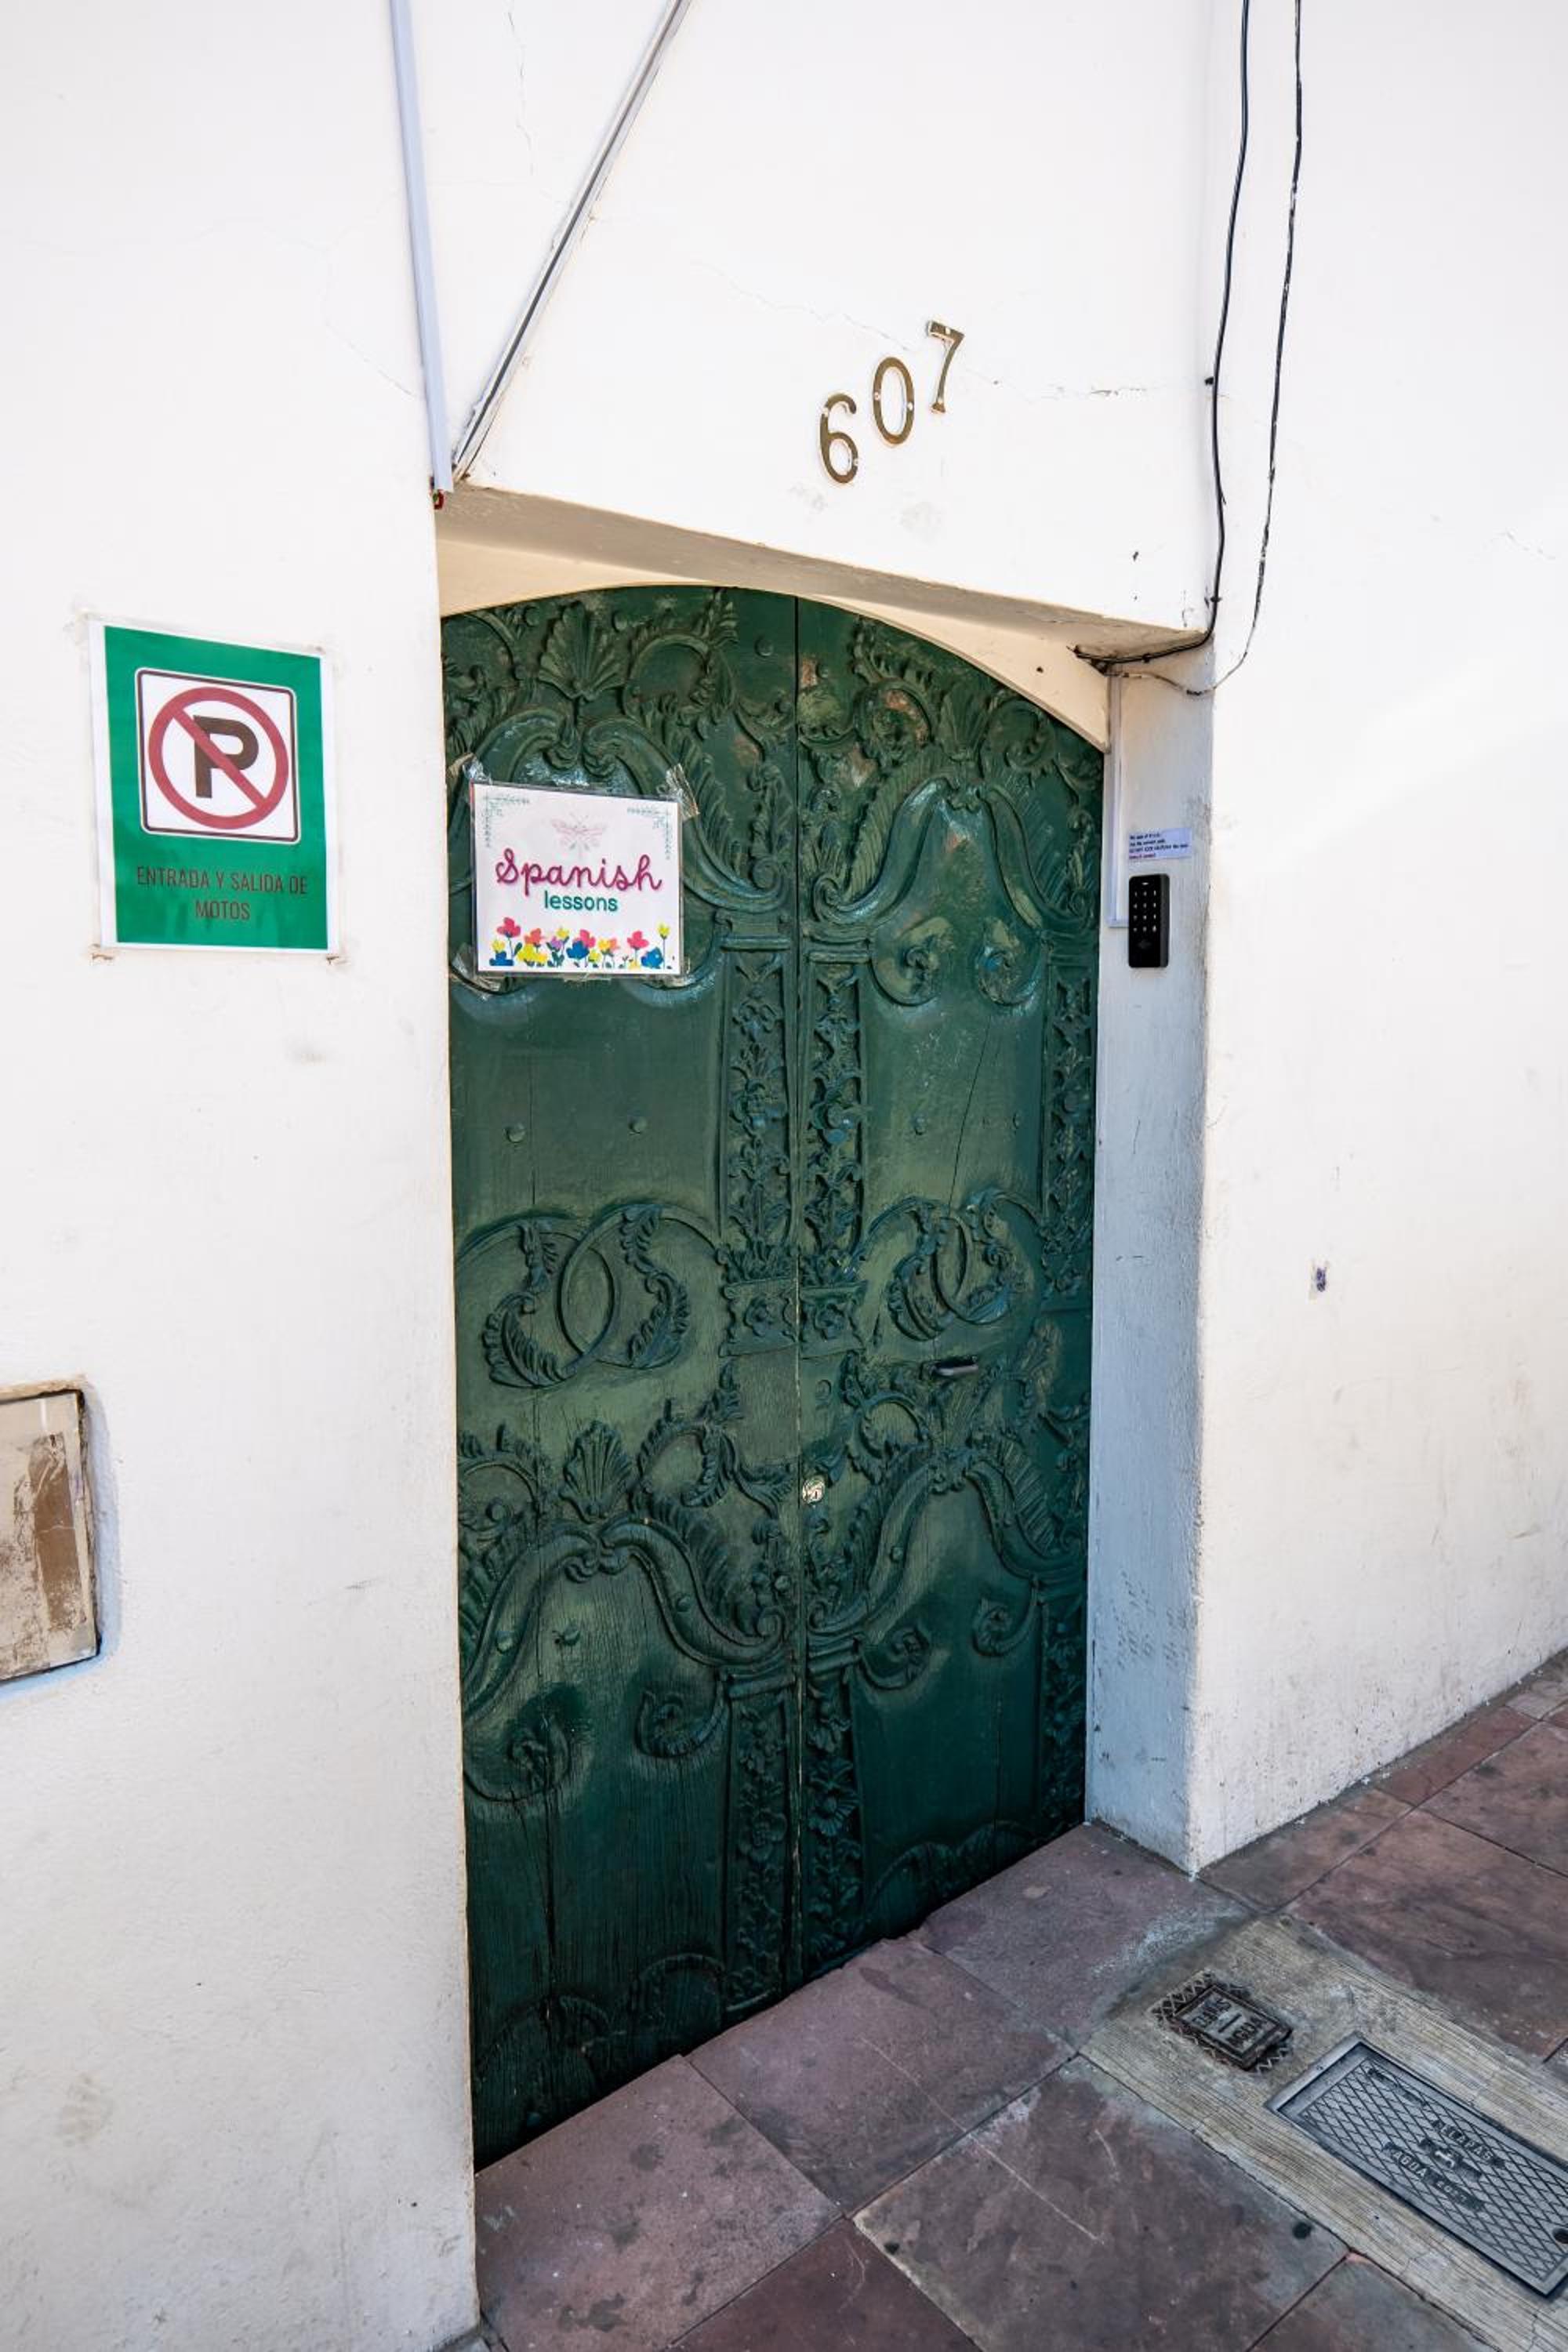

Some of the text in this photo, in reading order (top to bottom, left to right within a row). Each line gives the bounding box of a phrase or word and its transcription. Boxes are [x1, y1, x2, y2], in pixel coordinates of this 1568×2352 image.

[819, 320, 965, 484] 607
[192, 714, 260, 799] P
[136, 866, 308, 895] ENTRADA Y SALIDA DE
[495, 848, 662, 896] Spanish
[195, 899, 251, 921] MOTOS
[544, 891, 619, 913] lessons
